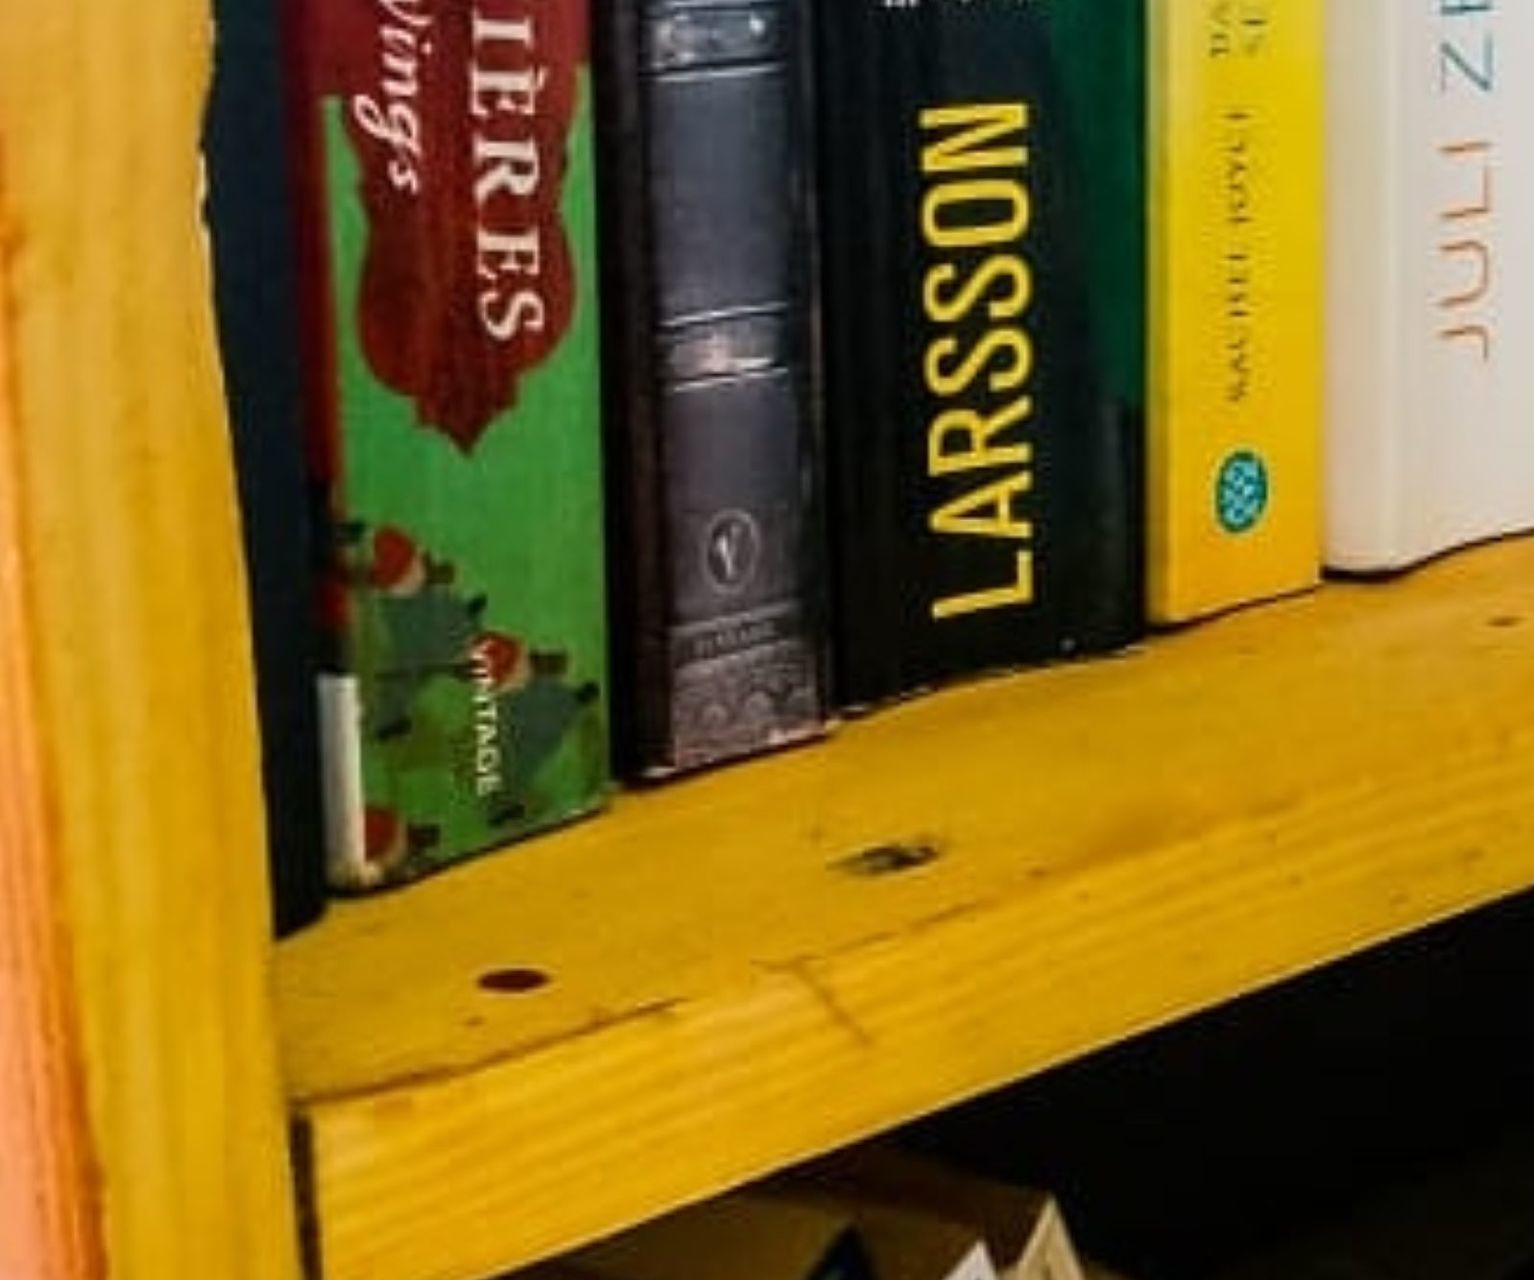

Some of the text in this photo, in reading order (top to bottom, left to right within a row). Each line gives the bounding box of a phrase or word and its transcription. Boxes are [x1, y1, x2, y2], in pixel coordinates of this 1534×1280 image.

[1436, 140, 1494, 359] JULI
[919, 102, 1033, 620] LARSSON
[469, 641, 500, 795] VINTAGE
